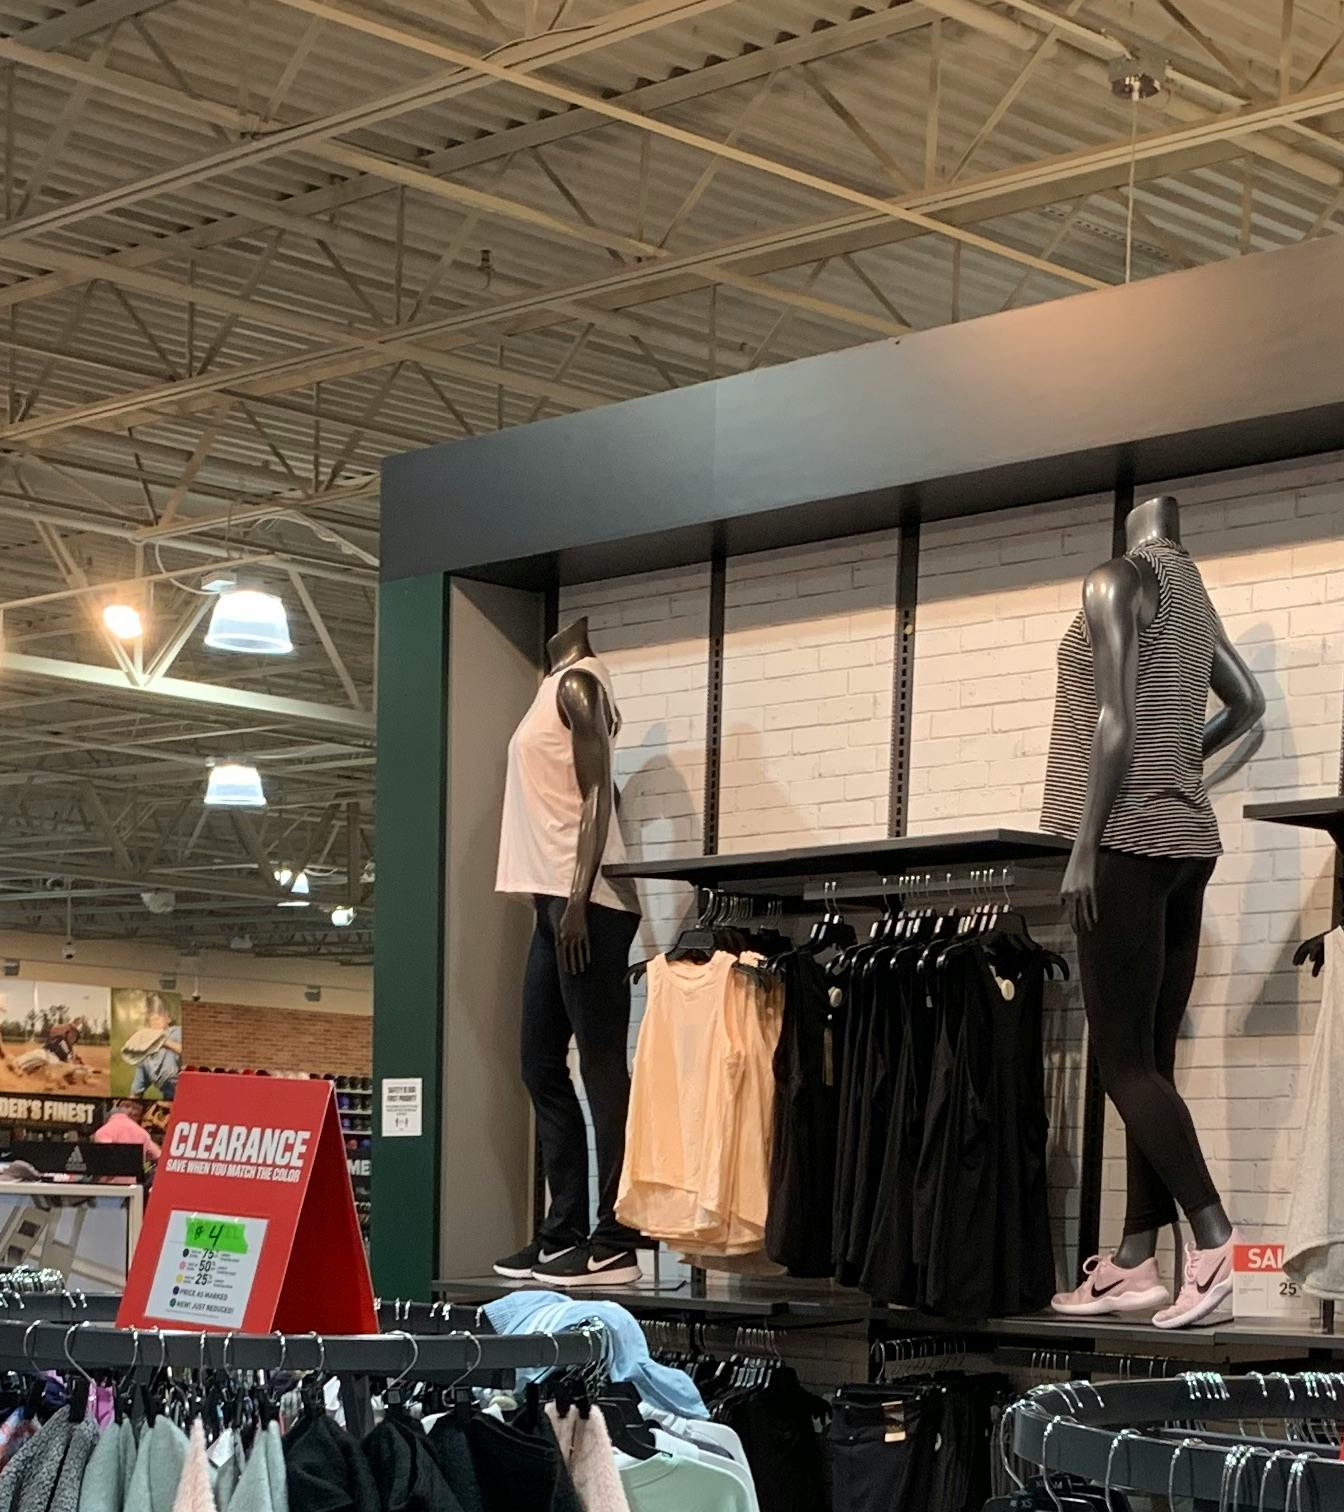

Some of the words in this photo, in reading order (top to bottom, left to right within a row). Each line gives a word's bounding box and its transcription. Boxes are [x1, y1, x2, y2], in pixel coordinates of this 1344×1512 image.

[43, 1100, 95, 1125] FINEST
[170, 1121, 311, 1167] CLEARANCE
[165, 1158, 187, 1173] SAVE
[187, 1159, 211, 1175] WHEN
[210, 1162, 227, 1177] YOU
[227, 1163, 256, 1179] MATCH
[256, 1166, 273, 1181] THE
[272, 1168, 301, 1183] COLOR
[1248, 1248, 1283, 1269] SAL
